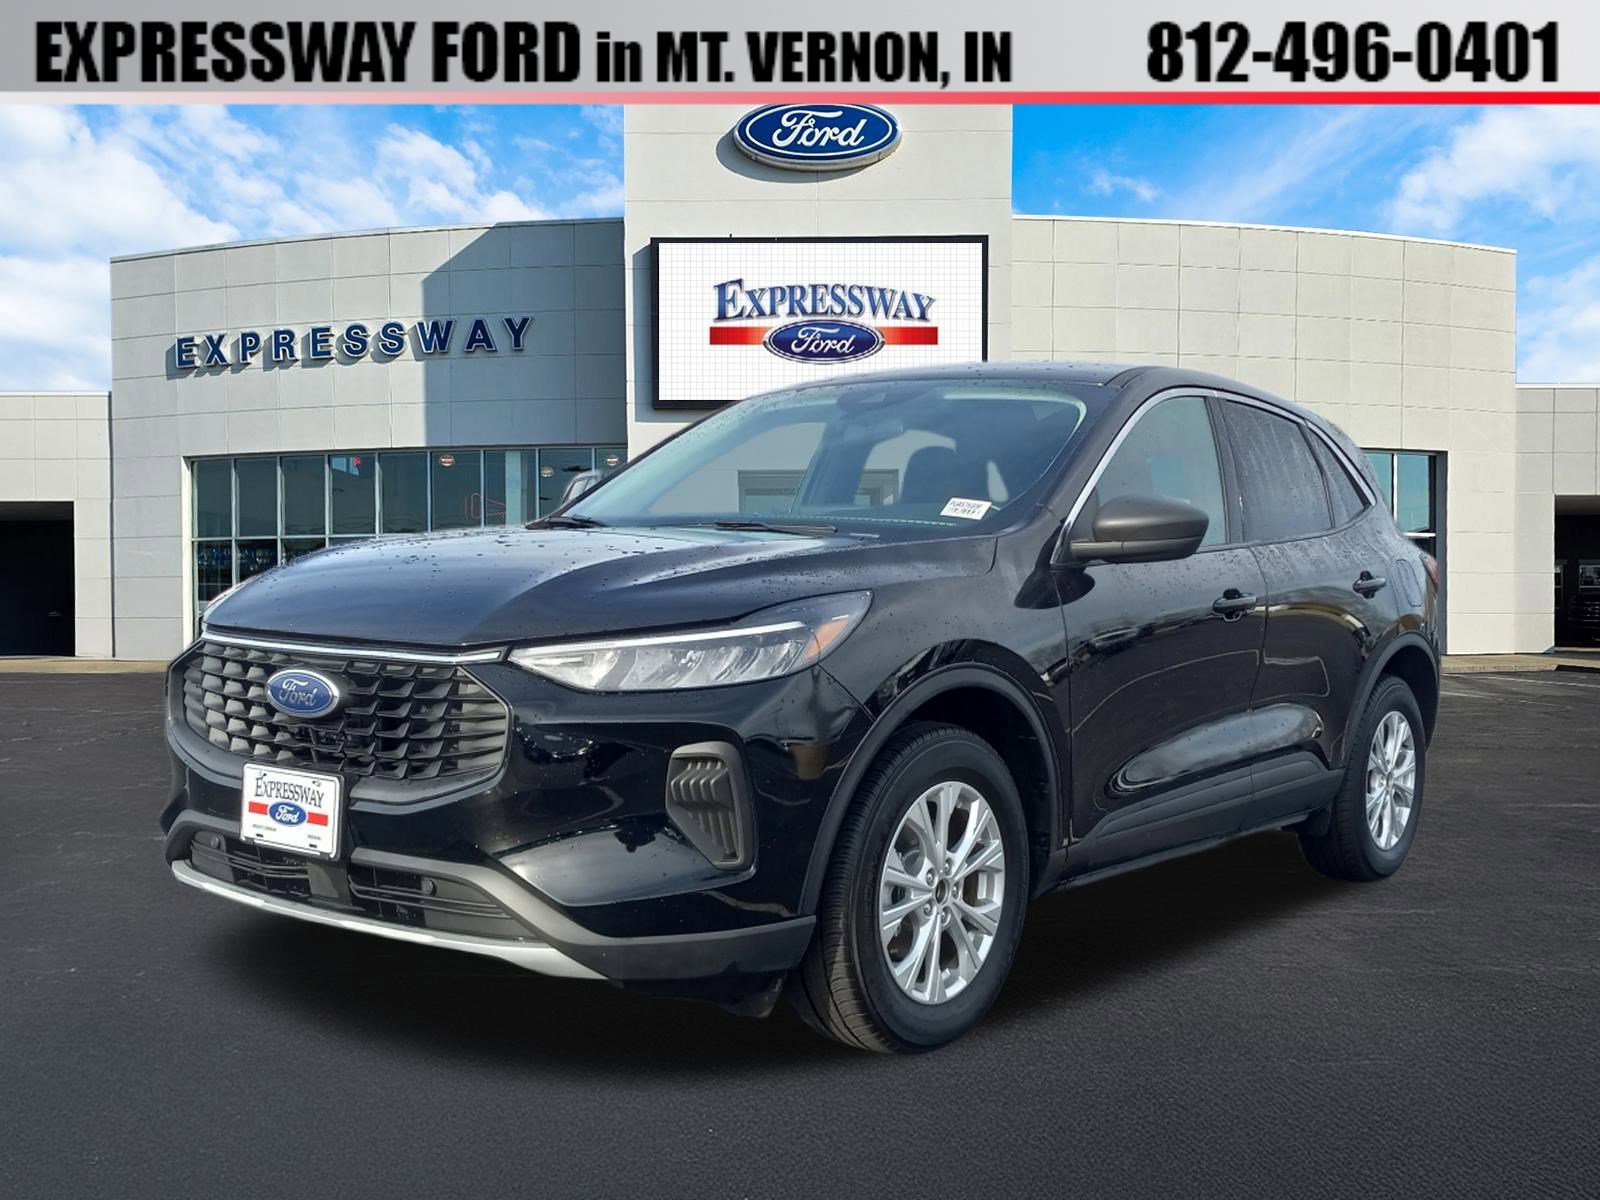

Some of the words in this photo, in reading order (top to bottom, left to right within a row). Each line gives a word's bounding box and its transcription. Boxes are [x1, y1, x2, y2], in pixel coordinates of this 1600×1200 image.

[772, 109, 864, 147] Ford
[175, 316, 532, 368] EXPRESSWAY
[791, 326, 855, 354] Ford
[279, 678, 318, 706] Ford
[275, 806, 299, 823] Ford
